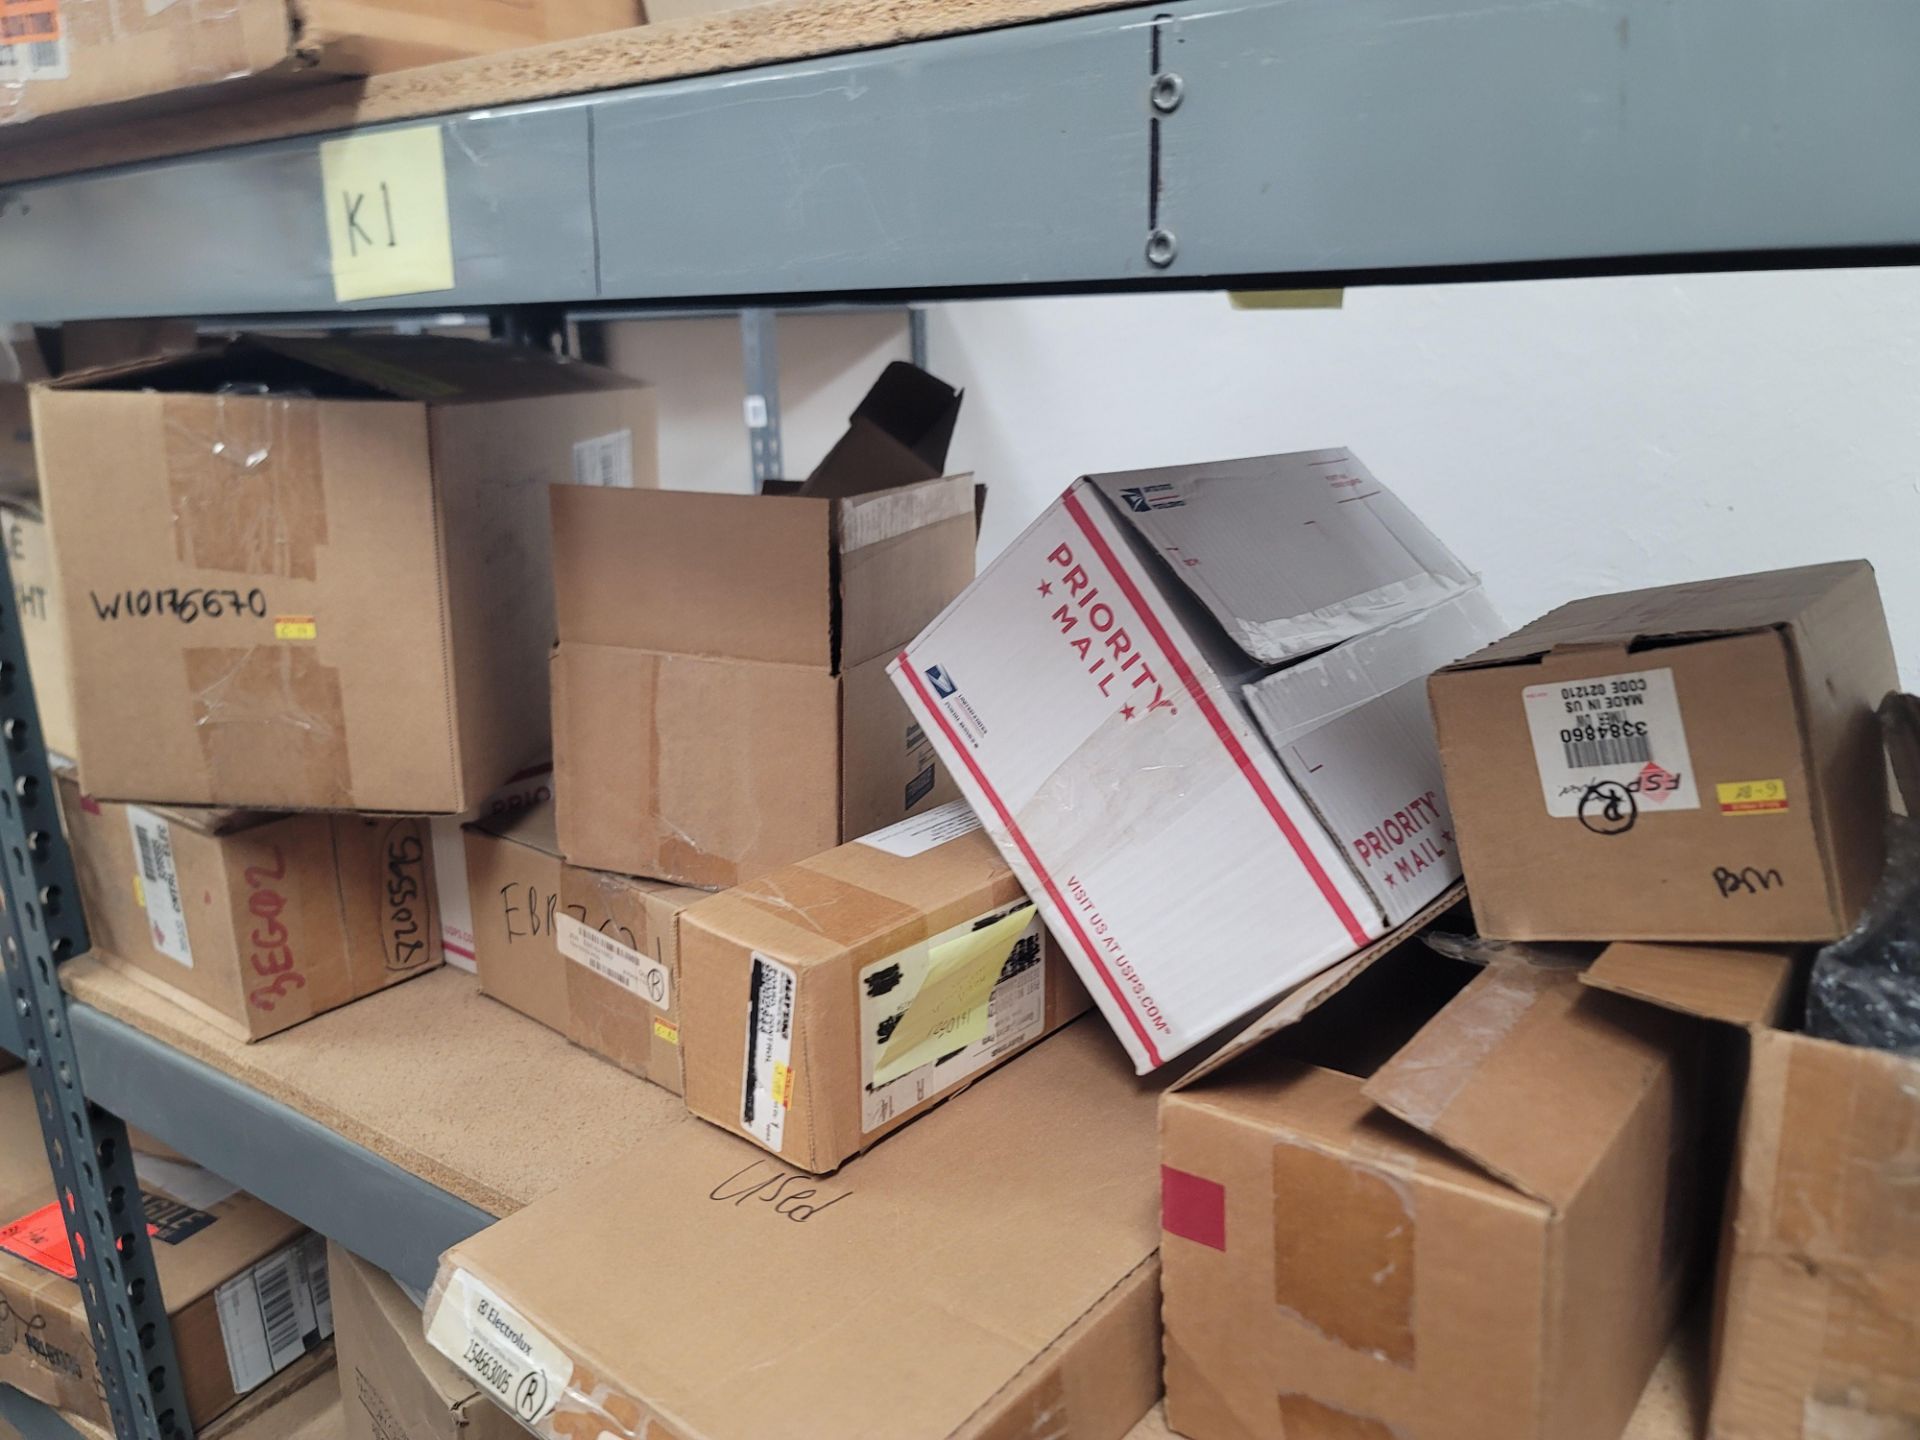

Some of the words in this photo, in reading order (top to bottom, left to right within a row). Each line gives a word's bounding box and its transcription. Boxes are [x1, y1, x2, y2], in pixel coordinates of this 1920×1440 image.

[1052, 603, 1115, 698] MAIL
[1610, 678, 1647, 693] CODE
[1564, 700, 1582, 713] US
[1587, 697, 1601, 711] IN
[1605, 693, 1644, 709] MADE
[1559, 720, 1648, 743] 3384860
[1626, 772, 1681, 793] FSP
[1394, 838, 1446, 882] MAIL
[1067, 875, 1095, 911] VISIT
[1090, 913, 1108, 935] US
[1102, 937, 1122, 953] AT
[710, 1159, 853, 1223] Used
[487, 1308, 533, 1356] Electrolux
